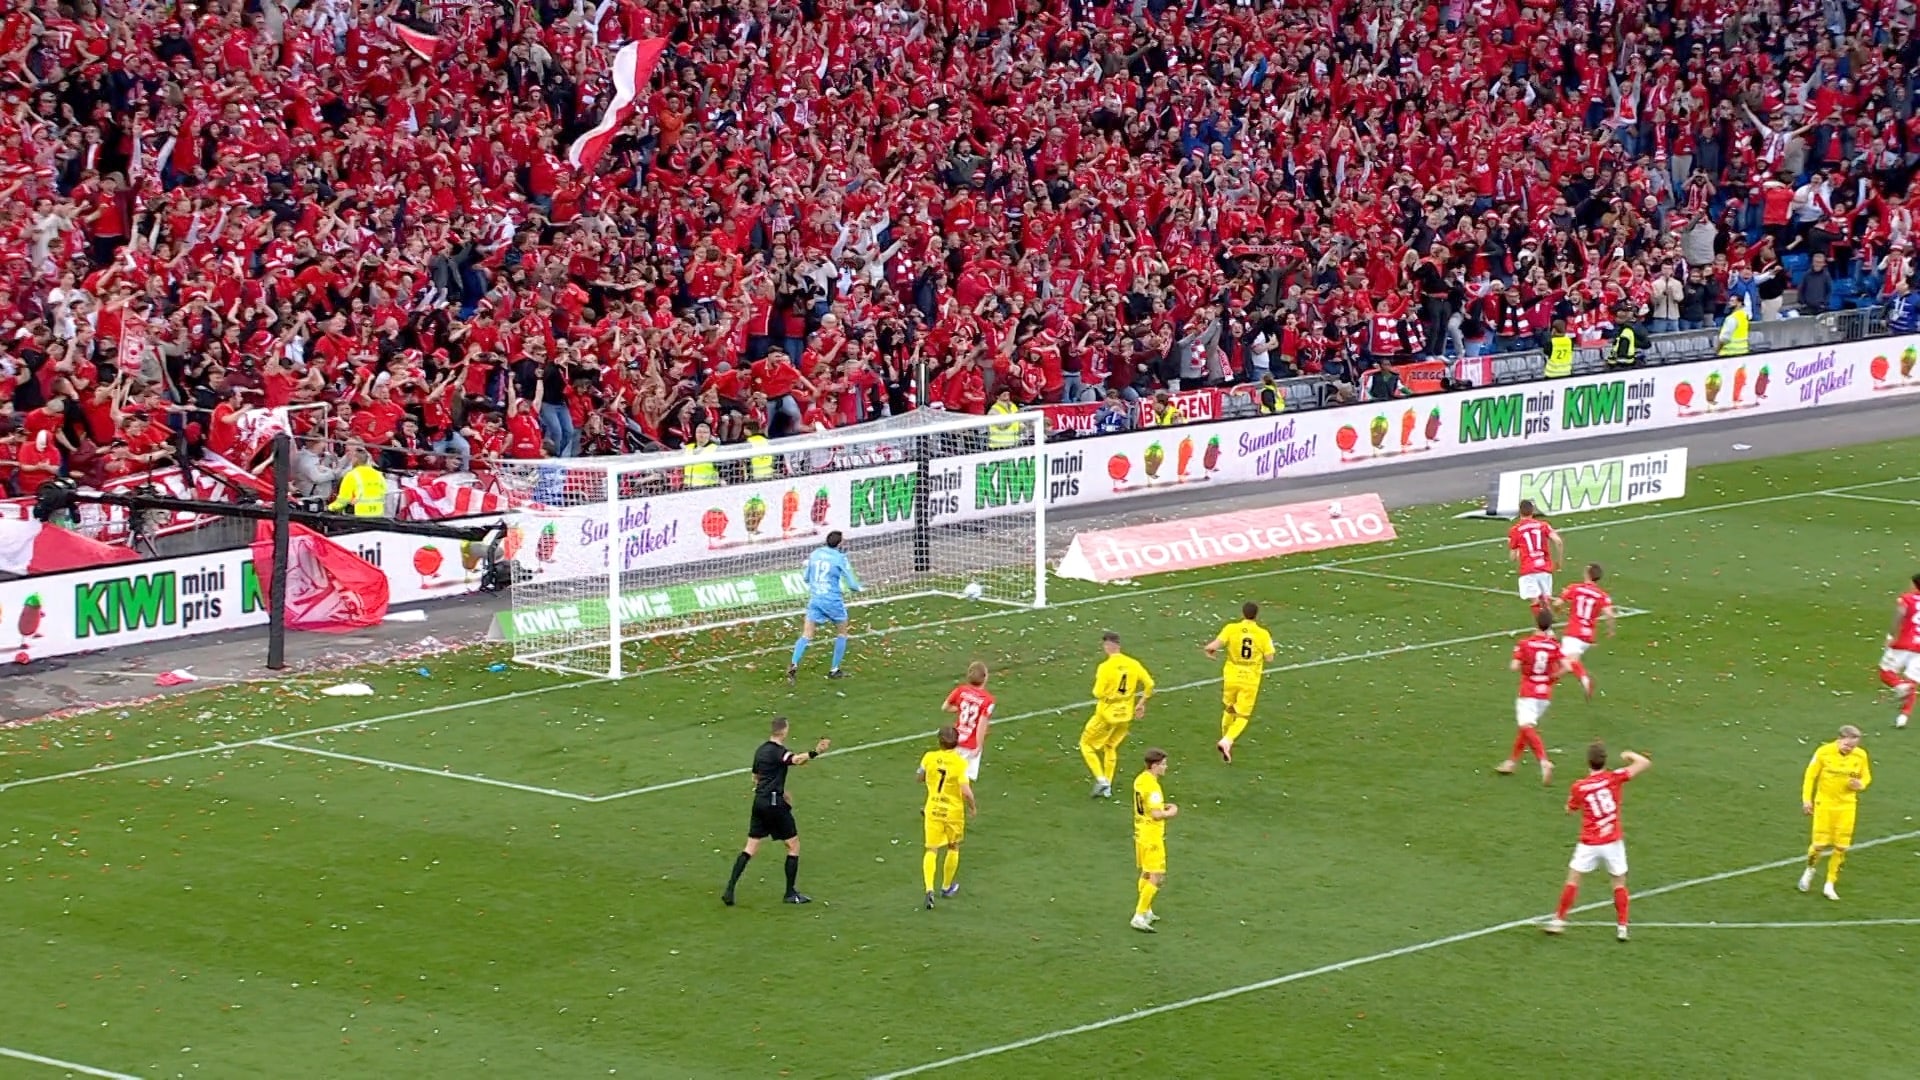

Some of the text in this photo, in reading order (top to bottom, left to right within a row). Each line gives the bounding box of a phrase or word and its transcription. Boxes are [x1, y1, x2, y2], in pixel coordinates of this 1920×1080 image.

[1785, 350, 1836, 385] Sunnhet
[1526, 390, 1554, 413] mini
[1628, 377, 1655, 400] mini
[1800, 378, 1813, 402] til
[1143, 392, 1211, 427] BGEN
[1562, 380, 1625, 429] KIWI
[1626, 400, 1651, 426] pris
[1459, 393, 1523, 443] KIWI
[1525, 413, 1550, 438] pris
[1238, 418, 1296, 457] Sunnhet
[1051, 450, 1083, 475] mini
[1256, 450, 1270, 476] til
[1629, 454, 1668, 477] mini
[929, 466, 962, 492] mini
[975, 454, 1048, 509] KIW
[1051, 474, 1079, 503] pris
[1519, 460, 1623, 513] KIWI
[1628, 476, 1662, 500] pris
[850, 471, 919, 527] KIW
[929, 491, 959, 521] pris
[352, 541, 382, 568] ini
[1096, 511, 1384, 573] thonhotels.no
[1522, 529, 1542, 555] 17
[182, 564, 225, 595] mini
[814, 560, 831, 582] 12
[75, 570, 177, 639] KIWI
[692, 582, 738, 608] KIWI
[182, 594, 222, 628] pris
[512, 608, 562, 635] KIWI
[1241, 637, 1252, 660] 6
[1533, 650, 1549, 674] 8
[1118, 673, 1127, 695] 4
[937, 768, 947, 793] 7
[1584, 788, 1617, 818] 18
